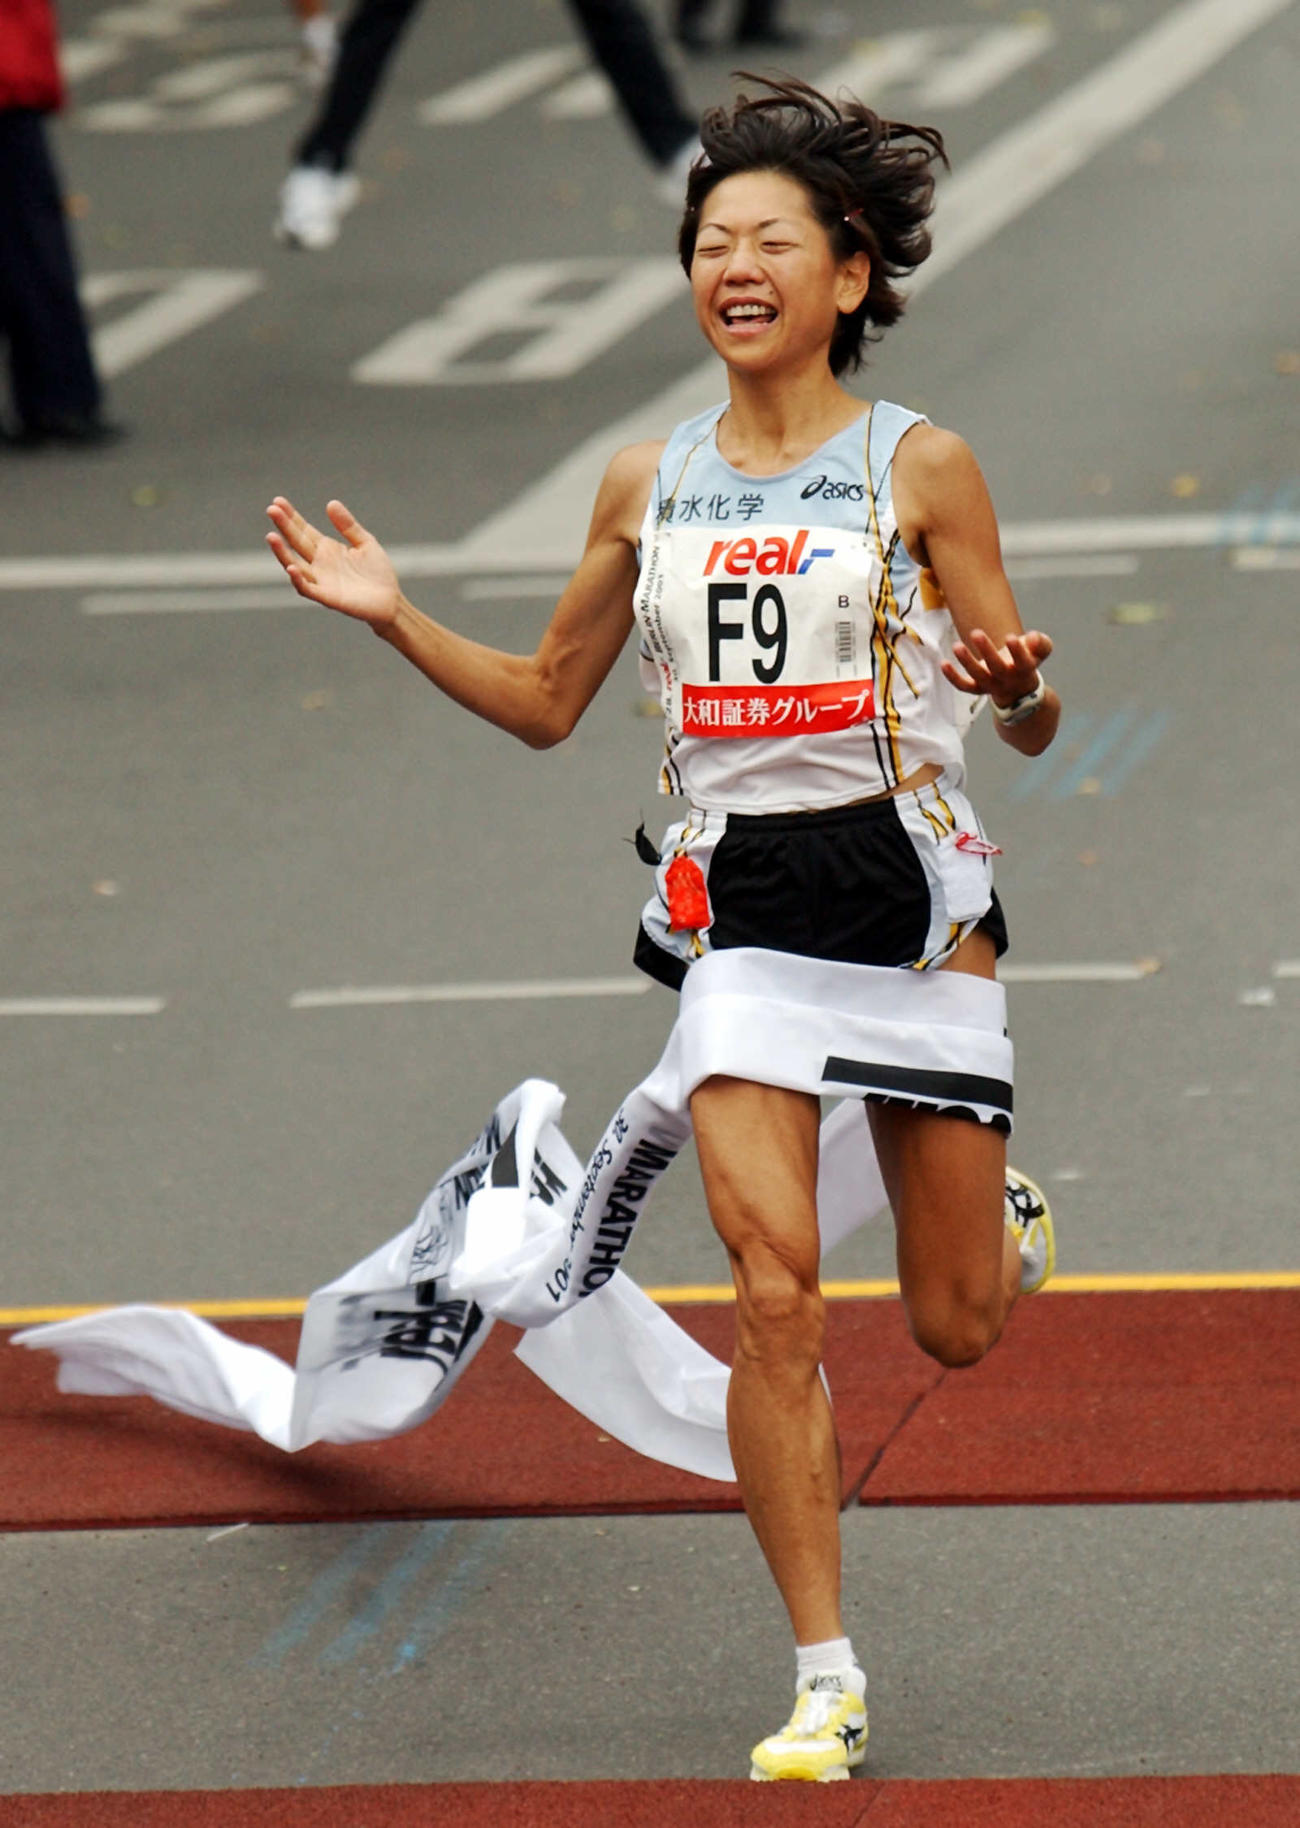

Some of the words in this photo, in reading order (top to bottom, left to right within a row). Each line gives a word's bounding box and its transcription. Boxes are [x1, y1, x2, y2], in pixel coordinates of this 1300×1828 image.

[837, 595, 850, 609] B
[708, 583, 787, 684] F9
[684, 689, 870, 726] 大和証券グループ
